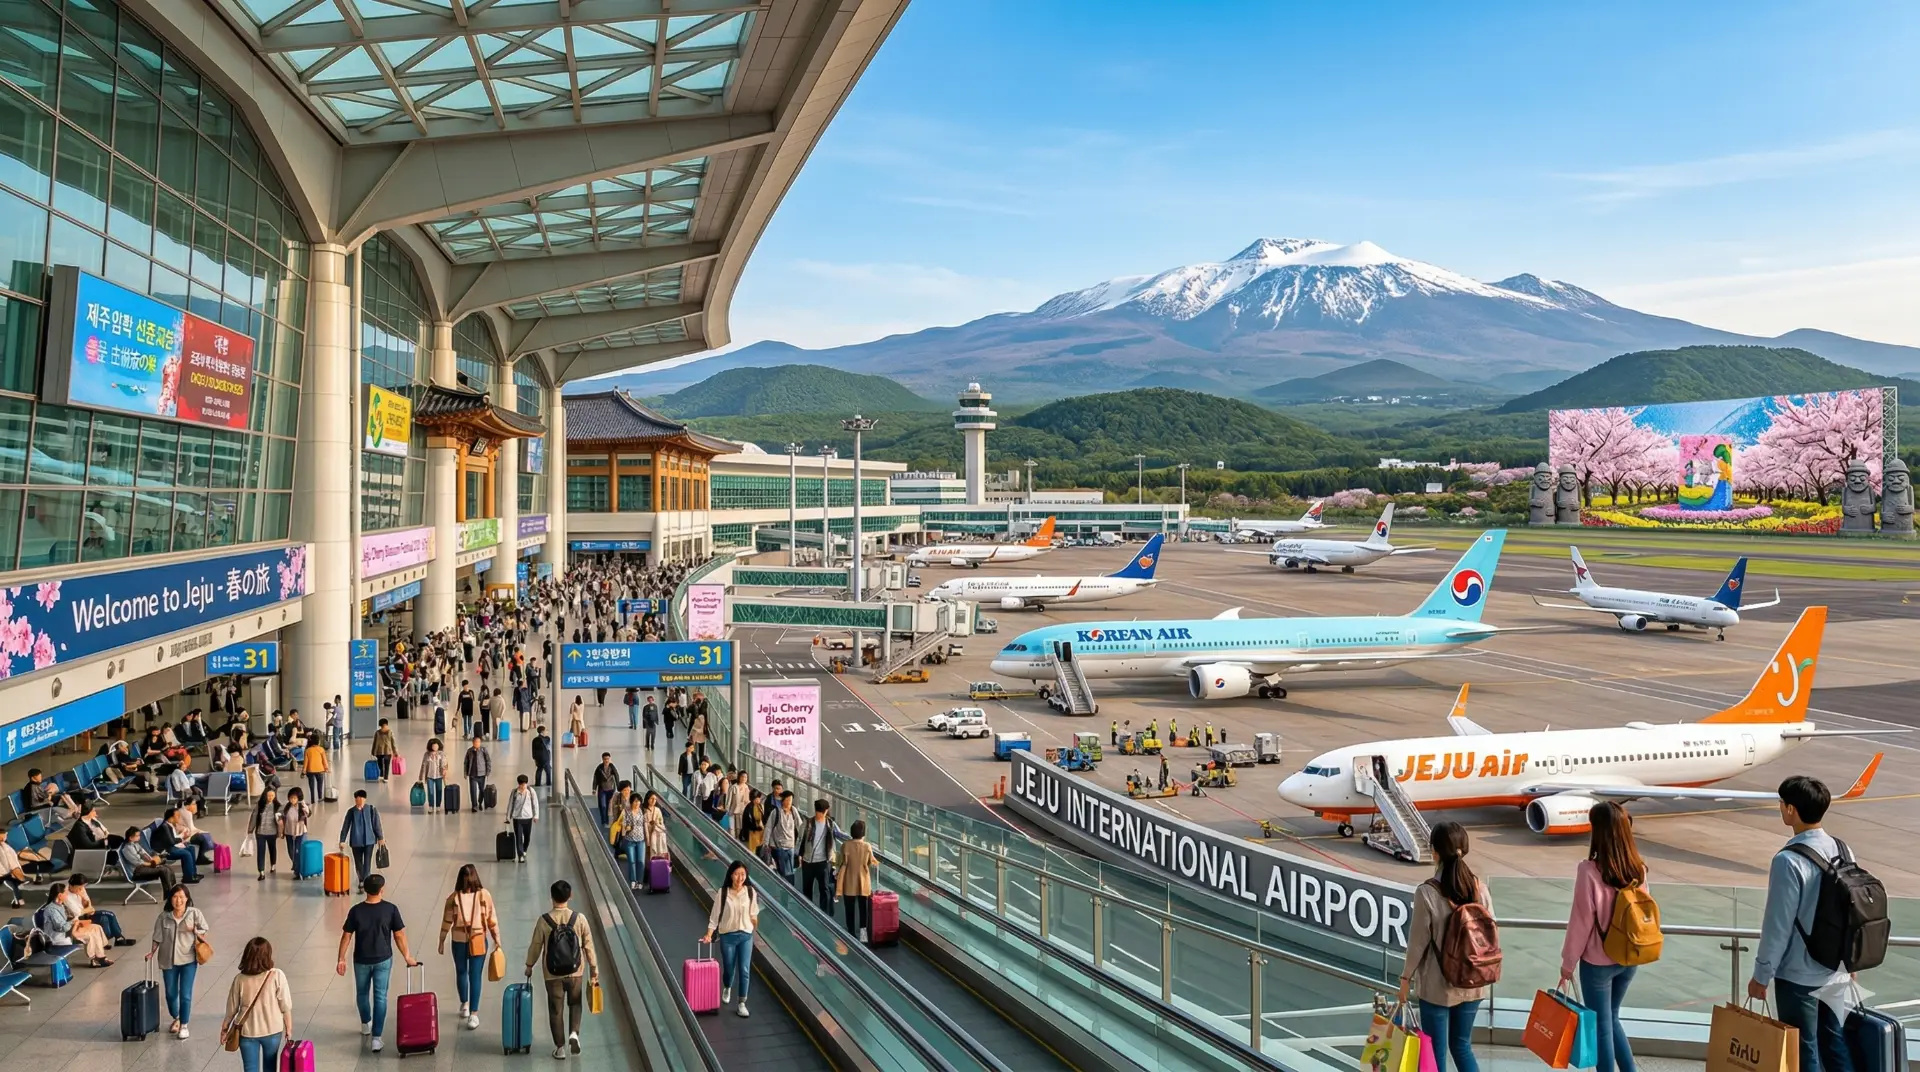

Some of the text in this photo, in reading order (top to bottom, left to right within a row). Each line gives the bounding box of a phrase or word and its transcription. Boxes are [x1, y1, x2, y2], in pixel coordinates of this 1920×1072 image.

[71, 593, 159, 633] Welcome
[163, 586, 180, 613] to
[182, 576, 214, 613] Jeju
[226, 562, 271, 602] 春の旅
[1076, 627, 1192, 643] KOREAN AIR
[243, 648, 268, 669] 31
[668, 645, 722, 665] Gate 31
[757, 703, 814, 715] Jeju Cherry
[765, 715, 806, 724] Blossom
[768, 725, 804, 736] Festival
[1394, 752, 1475, 783] JEJU
[1016, 762, 1414, 949] JEJU INTERNATIONAL AIRPOR
